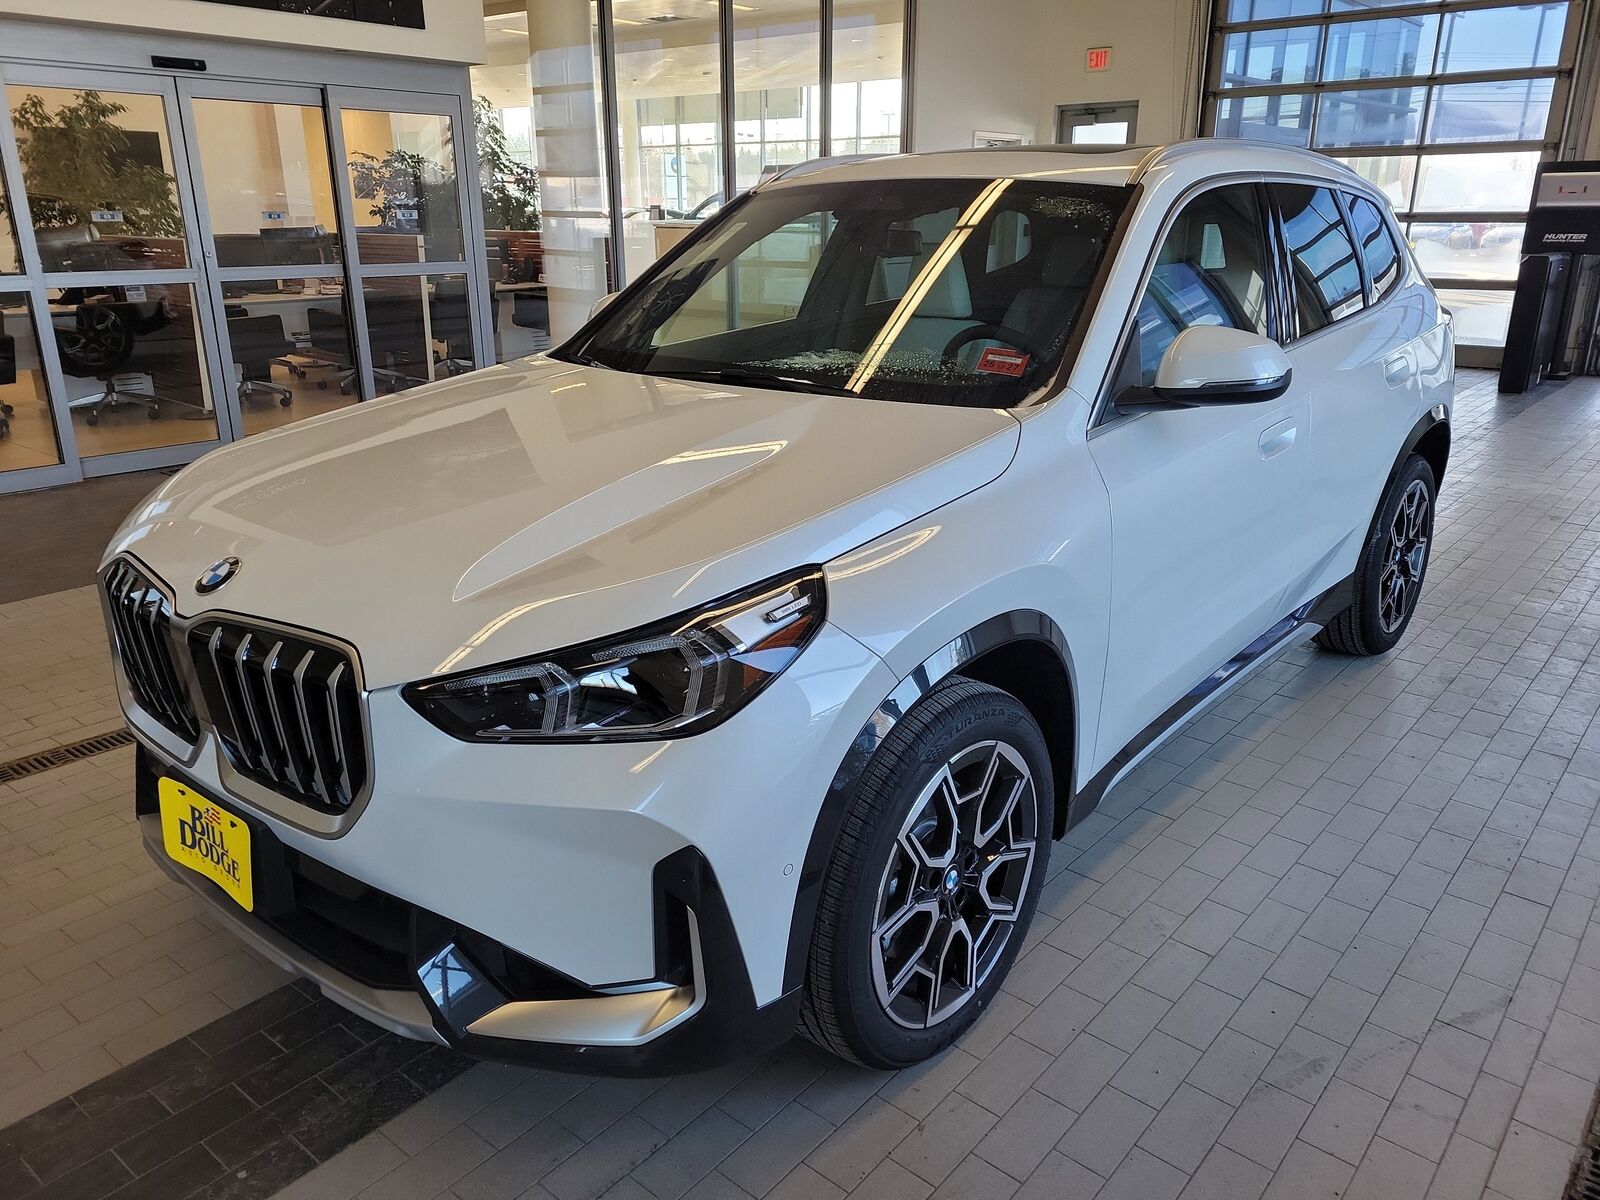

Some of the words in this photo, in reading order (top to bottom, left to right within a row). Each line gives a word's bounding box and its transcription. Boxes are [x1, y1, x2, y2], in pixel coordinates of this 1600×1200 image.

[1089, 50, 1108, 69] EXIT
[947, 708, 1005, 739] TURANZA
[189, 804, 229, 853] BILL
[178, 817, 241, 883] DODGE
